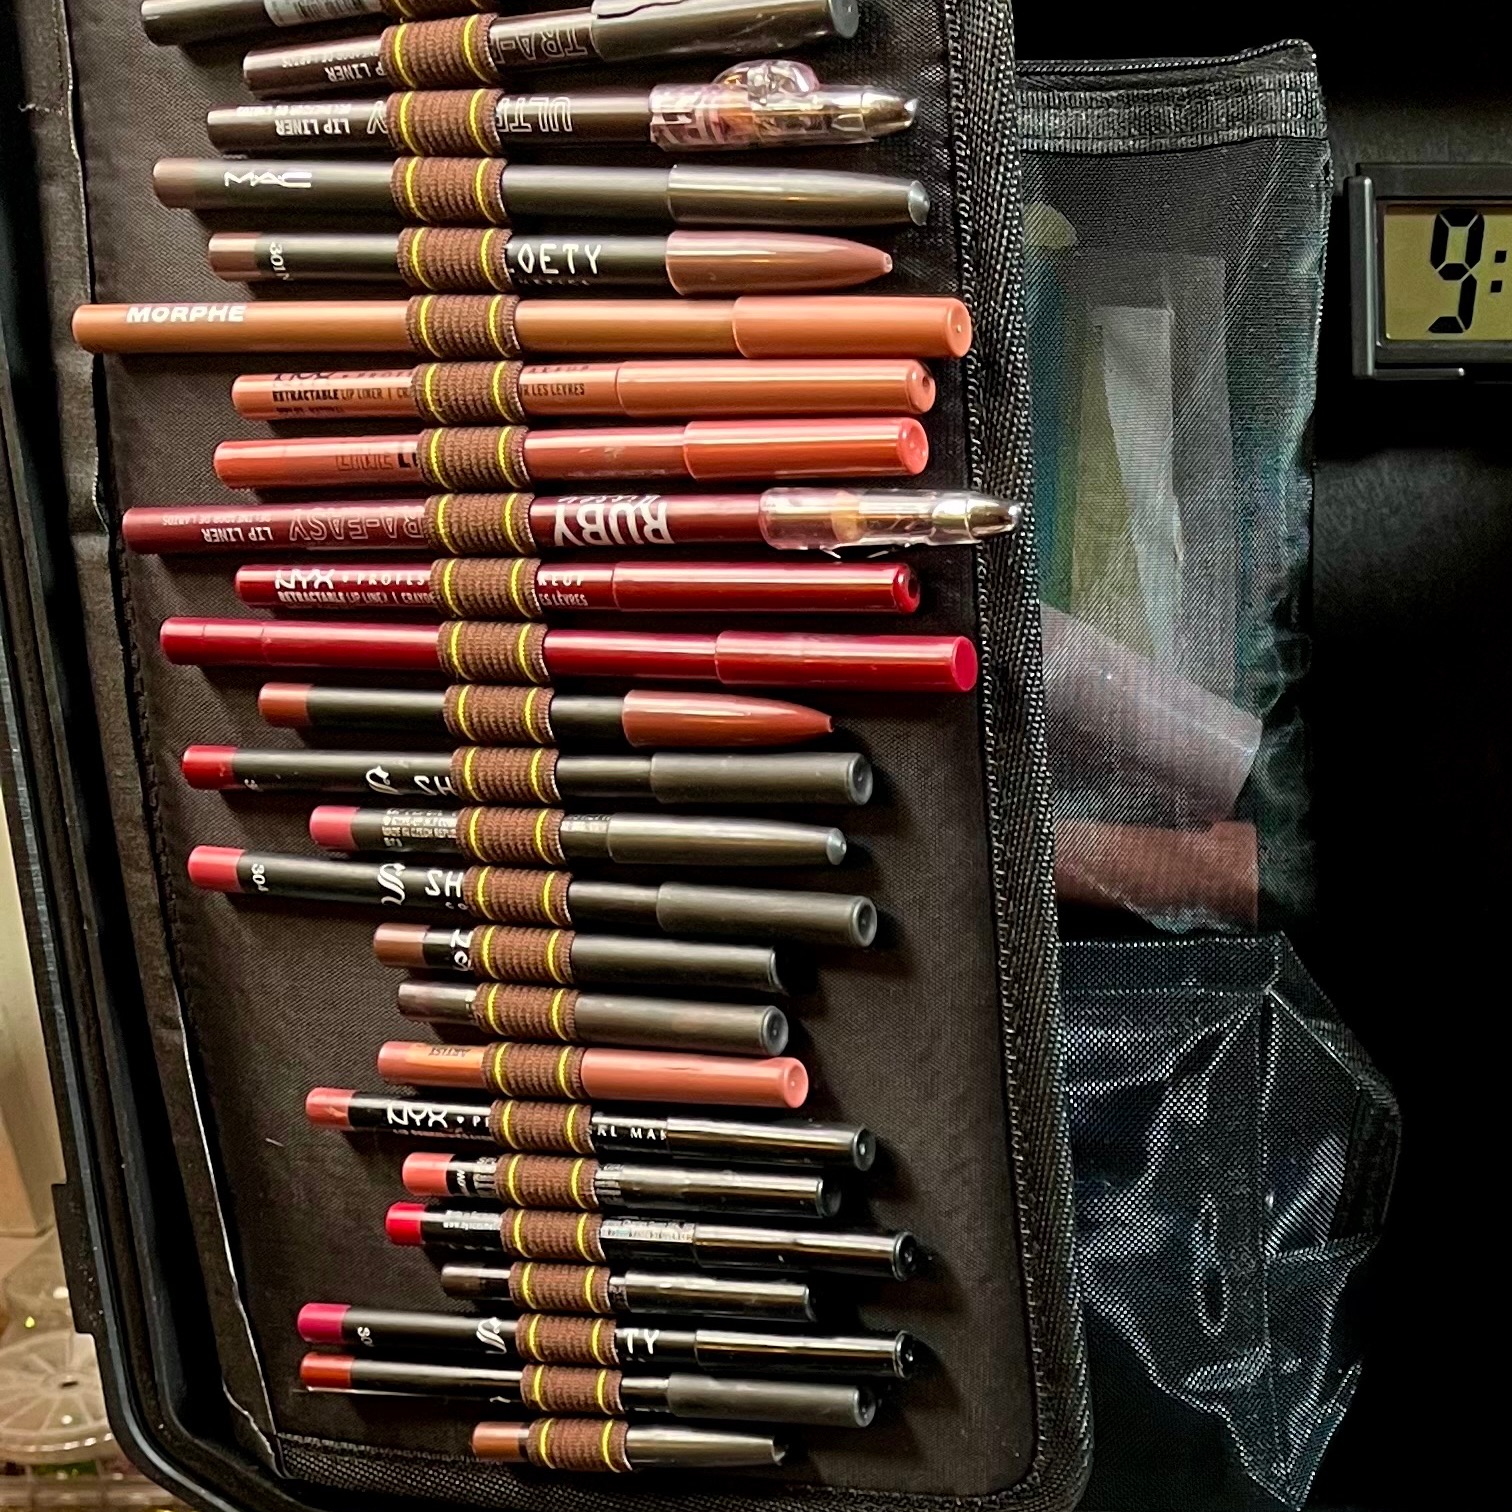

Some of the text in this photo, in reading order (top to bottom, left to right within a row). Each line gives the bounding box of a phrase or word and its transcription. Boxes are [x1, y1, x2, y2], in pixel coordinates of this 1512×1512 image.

[324, 62, 369, 83] LINER
[274, 118, 351, 136] LIP LINER
[224, 171, 313, 189] MAC
[127, 305, 246, 323] MORPHE
[552, 502, 675, 546] RUBY
[203, 526, 273, 543] LIP LINER
[275, 568, 337, 590] NYX
[386, 1103, 448, 1129] NYX
